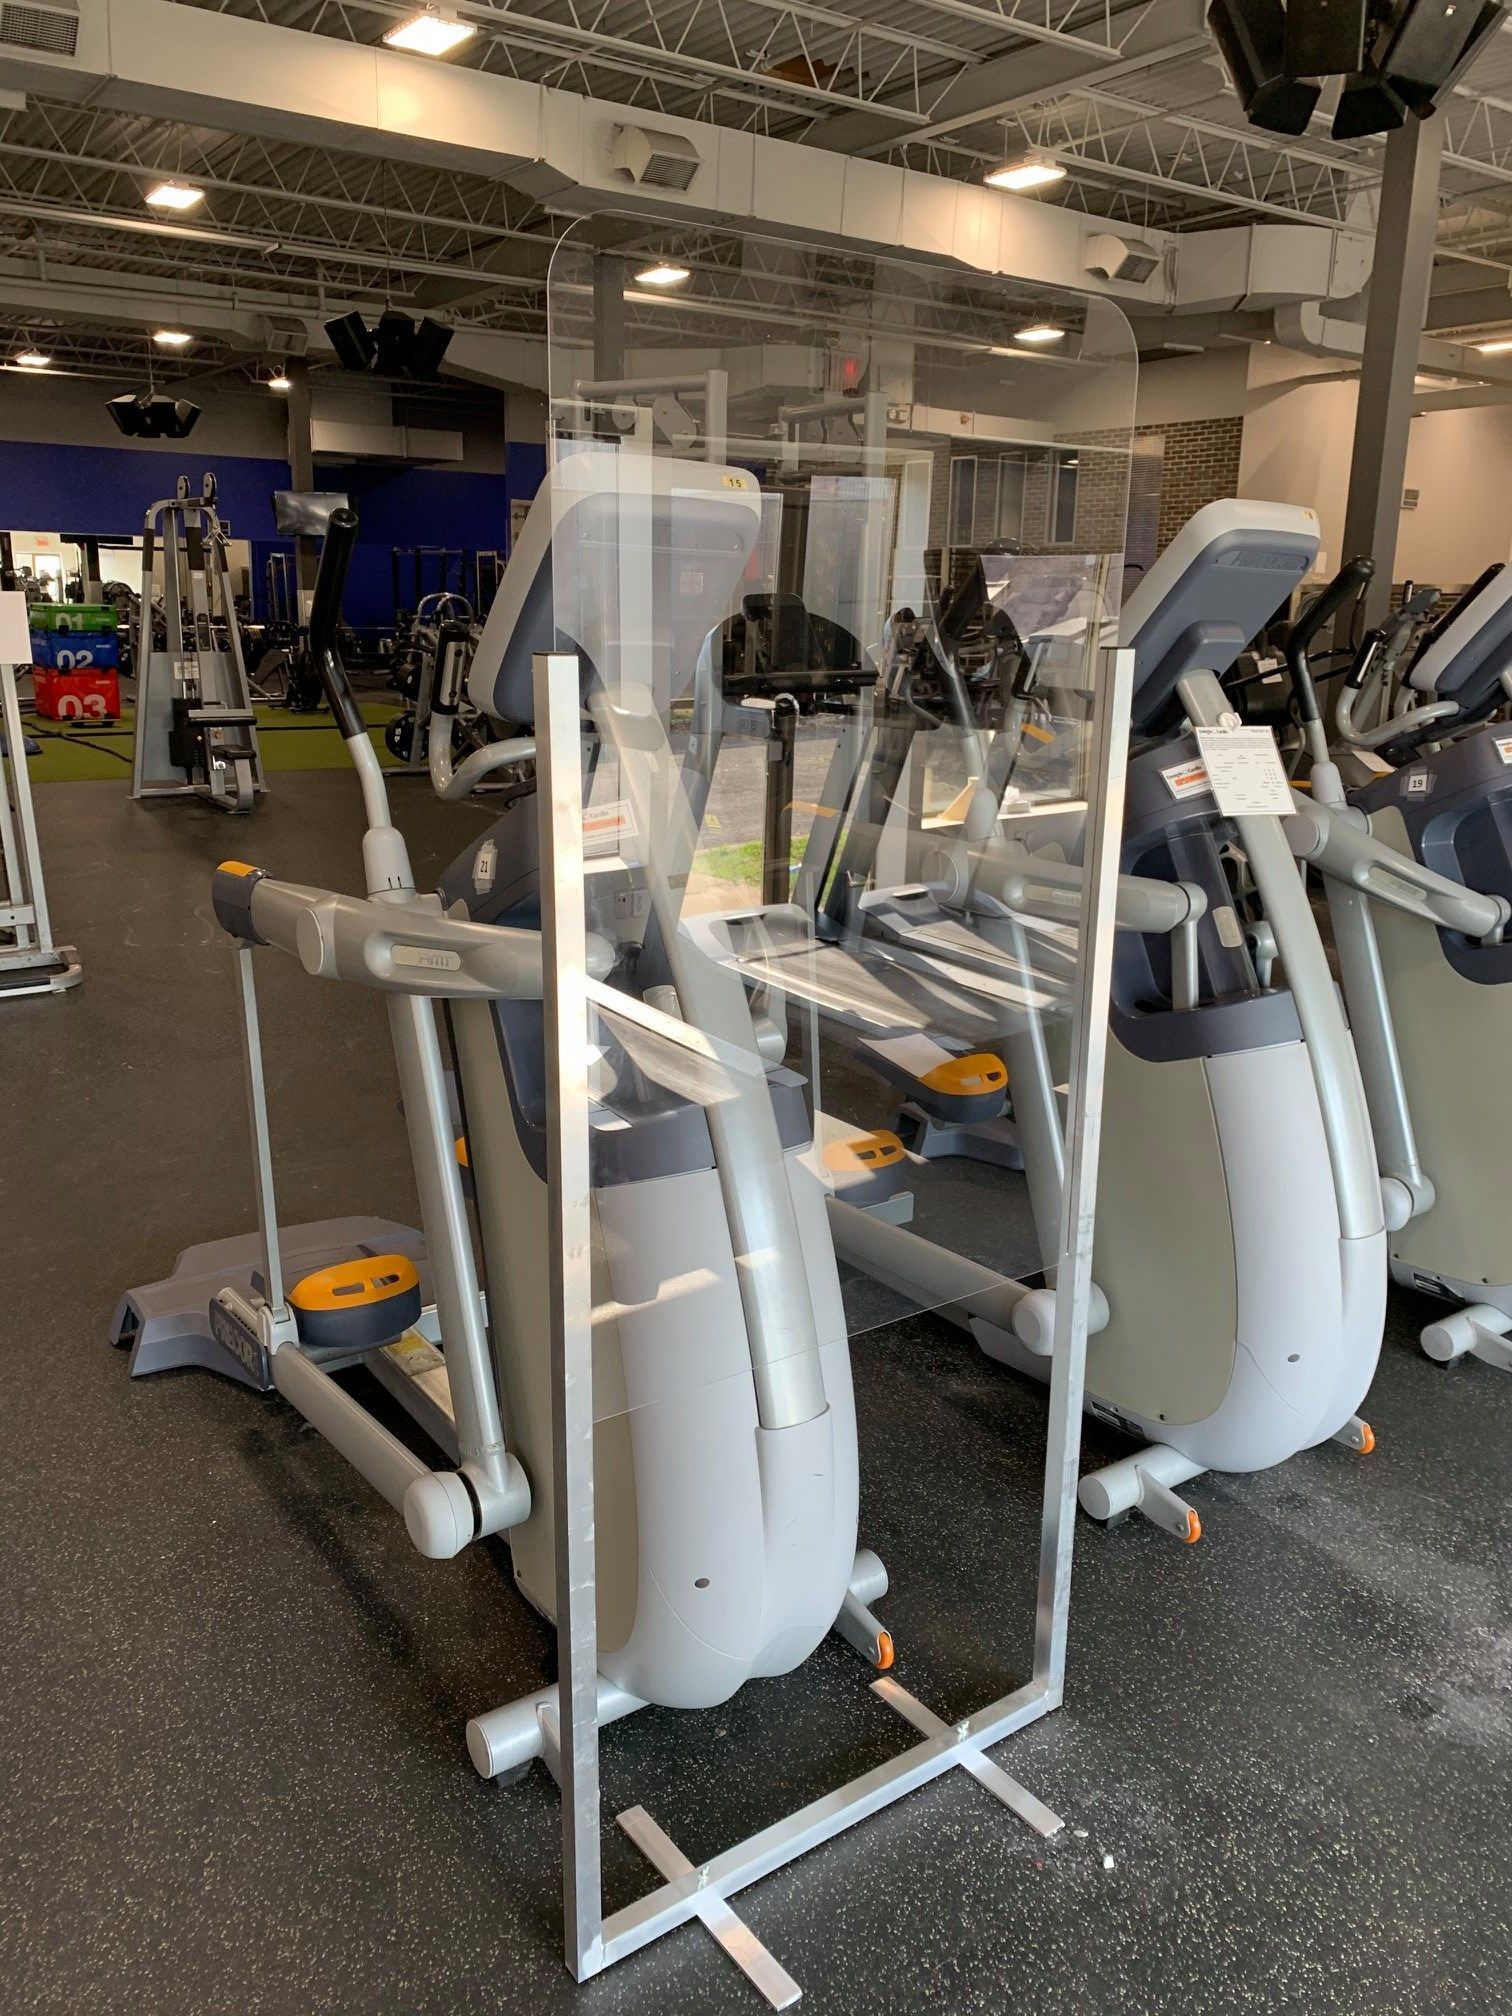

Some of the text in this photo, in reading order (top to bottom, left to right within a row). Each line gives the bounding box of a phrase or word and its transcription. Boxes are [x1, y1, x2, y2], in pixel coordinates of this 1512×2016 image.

[729, 478, 742, 488] 15
[55, 612, 83, 631] 01
[57, 649, 93, 670] 02
[57, 694, 108, 720] 03
[1412, 779, 1423, 788] 19
[480, 860, 488, 874] 21
